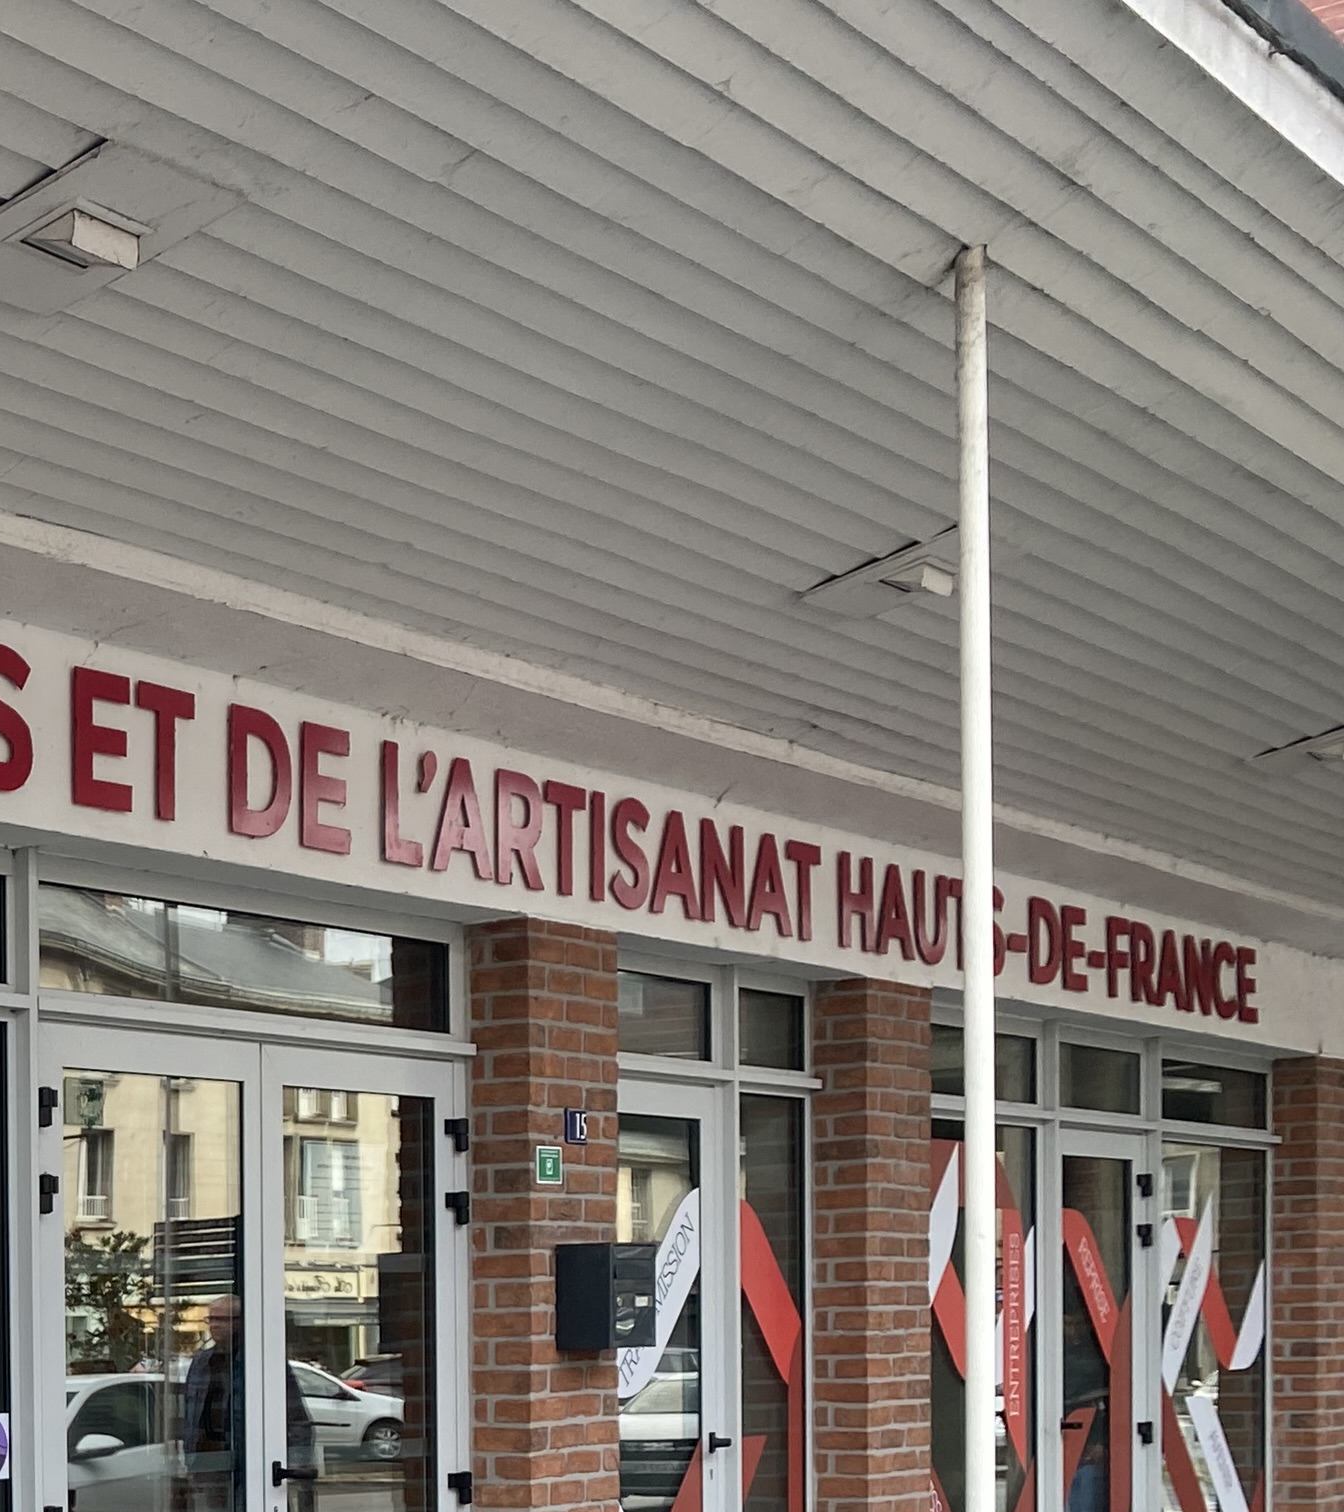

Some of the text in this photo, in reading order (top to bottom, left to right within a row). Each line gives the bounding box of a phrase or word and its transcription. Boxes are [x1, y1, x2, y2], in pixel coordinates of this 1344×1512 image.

[72, 666, 195, 821] ET
[228, 703, 351, 854] DE
[382, 740, 821, 942] L'ARTISANAT
[575, 1112, 588, 1139] 15
[1008, 1232, 1021, 1418] ENTREPRISES
